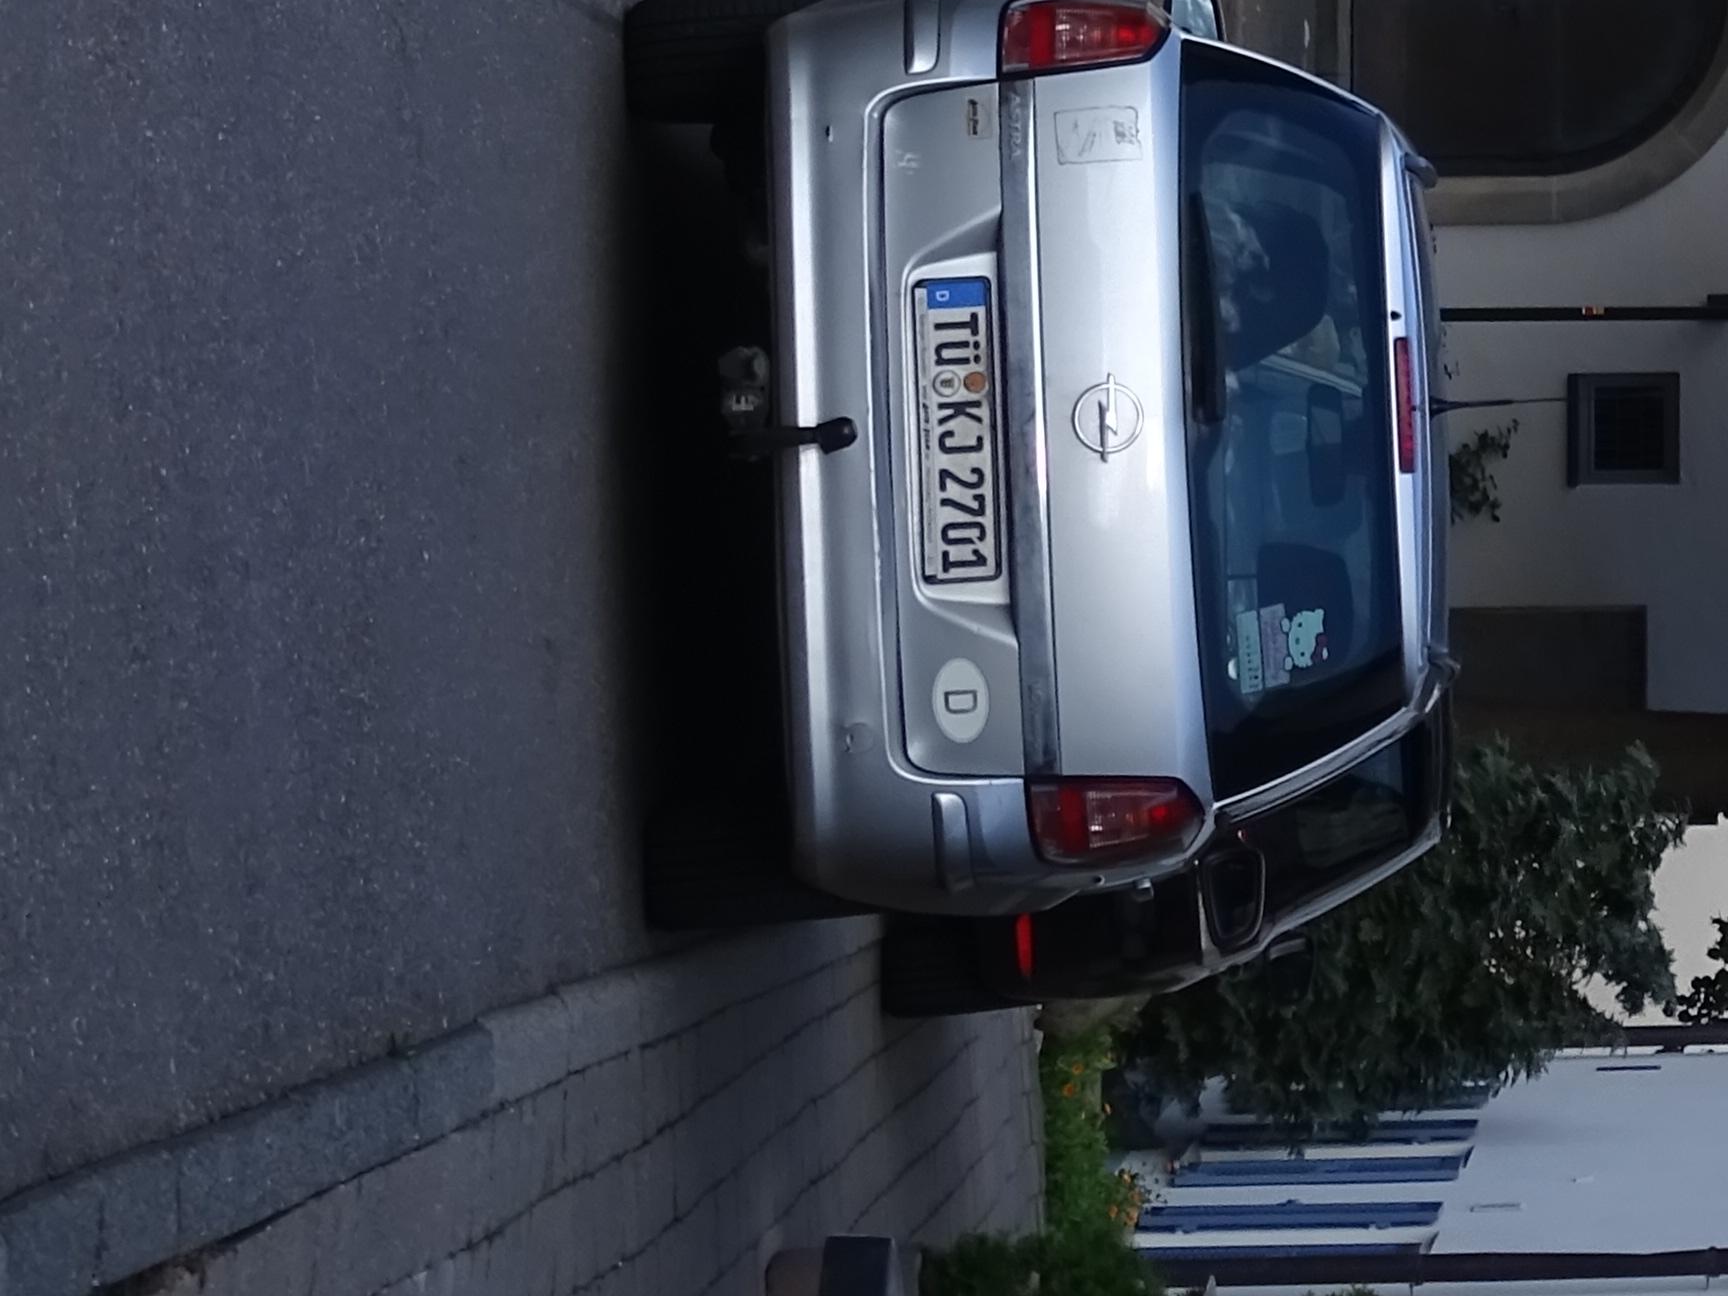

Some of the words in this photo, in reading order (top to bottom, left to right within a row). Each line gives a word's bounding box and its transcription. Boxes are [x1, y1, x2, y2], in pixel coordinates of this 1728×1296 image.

[1009, 93, 1022, 159] ASTRA
[936, 290, 951, 302] D
[933, 311, 982, 366] TÜ
[937, 400, 984, 455] KJ
[938, 466, 988, 574] 2701
[943, 689, 978, 715] D
